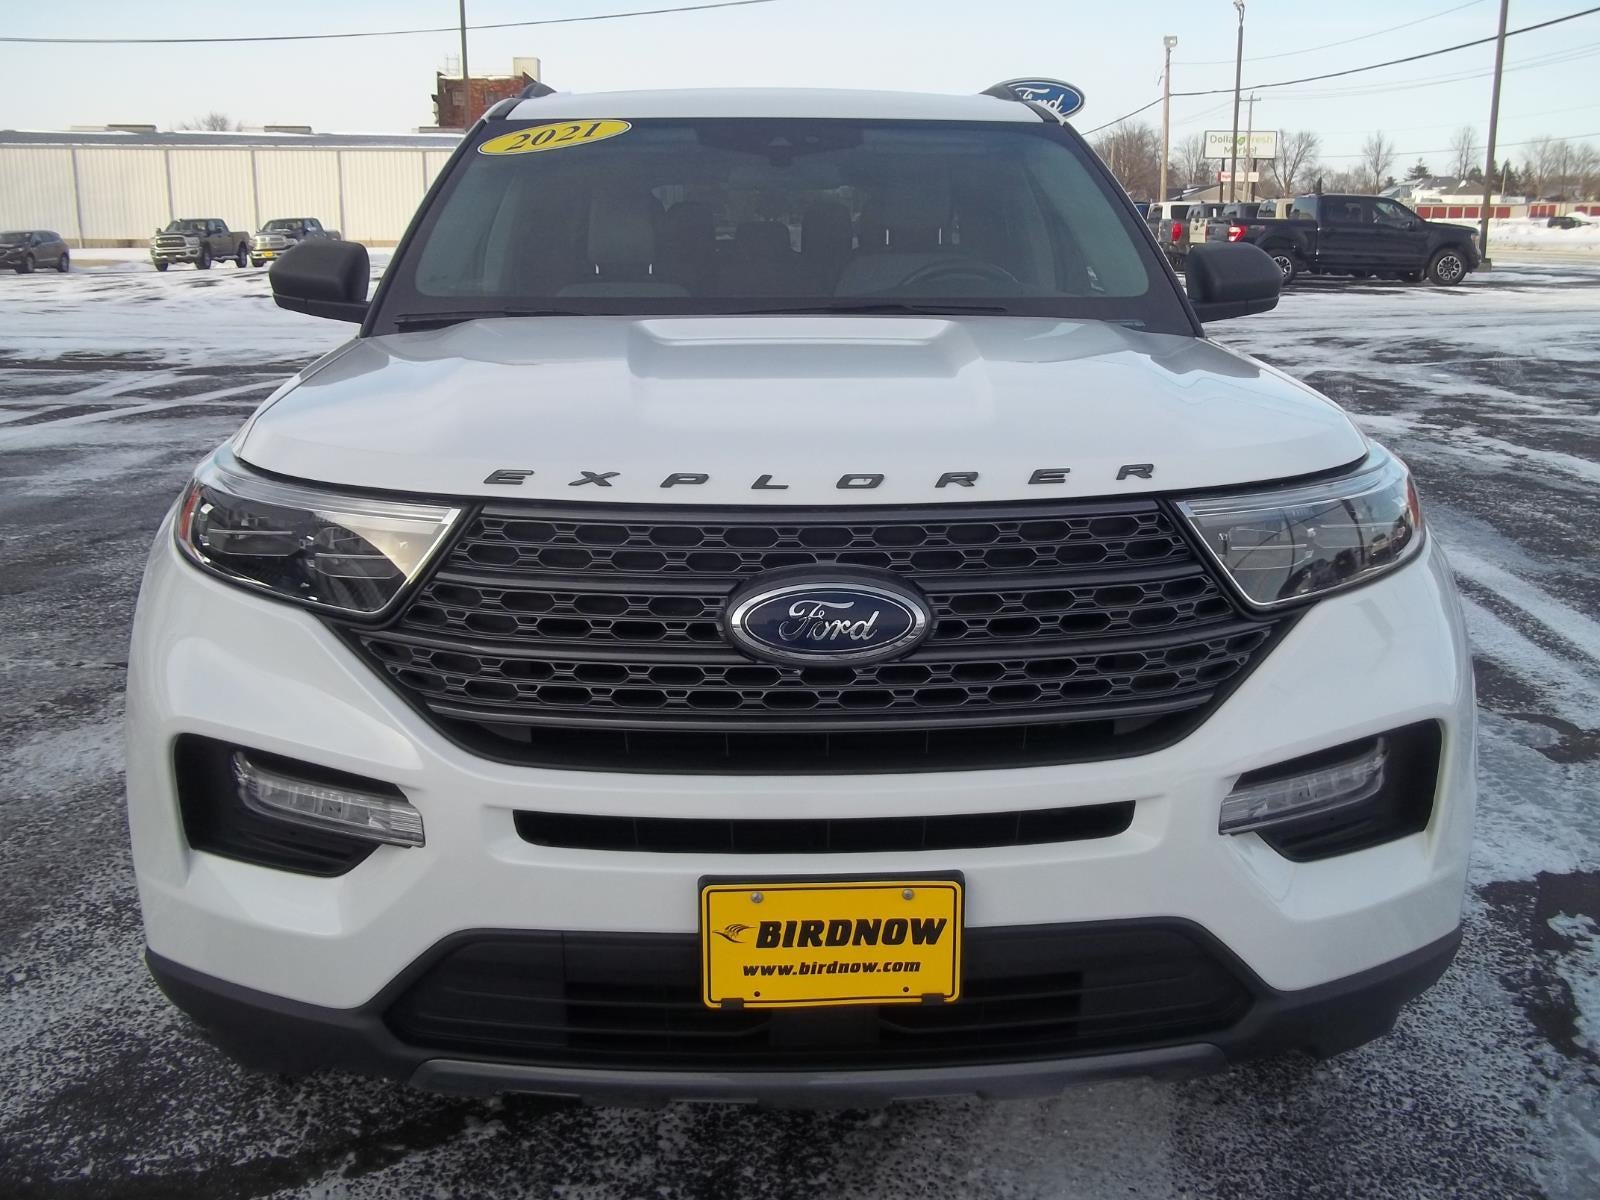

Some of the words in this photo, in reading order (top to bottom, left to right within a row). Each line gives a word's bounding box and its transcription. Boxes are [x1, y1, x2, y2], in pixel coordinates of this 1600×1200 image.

[504, 122, 602, 151] 2021
[1209, 134, 1235, 144] Dolla
[483, 463, 1155, 490] EXPLORER
[778, 600, 879, 641] Ford
[756, 918, 947, 948] BIRDNOW
[743, 961, 921, 977] www.birdnow.com
